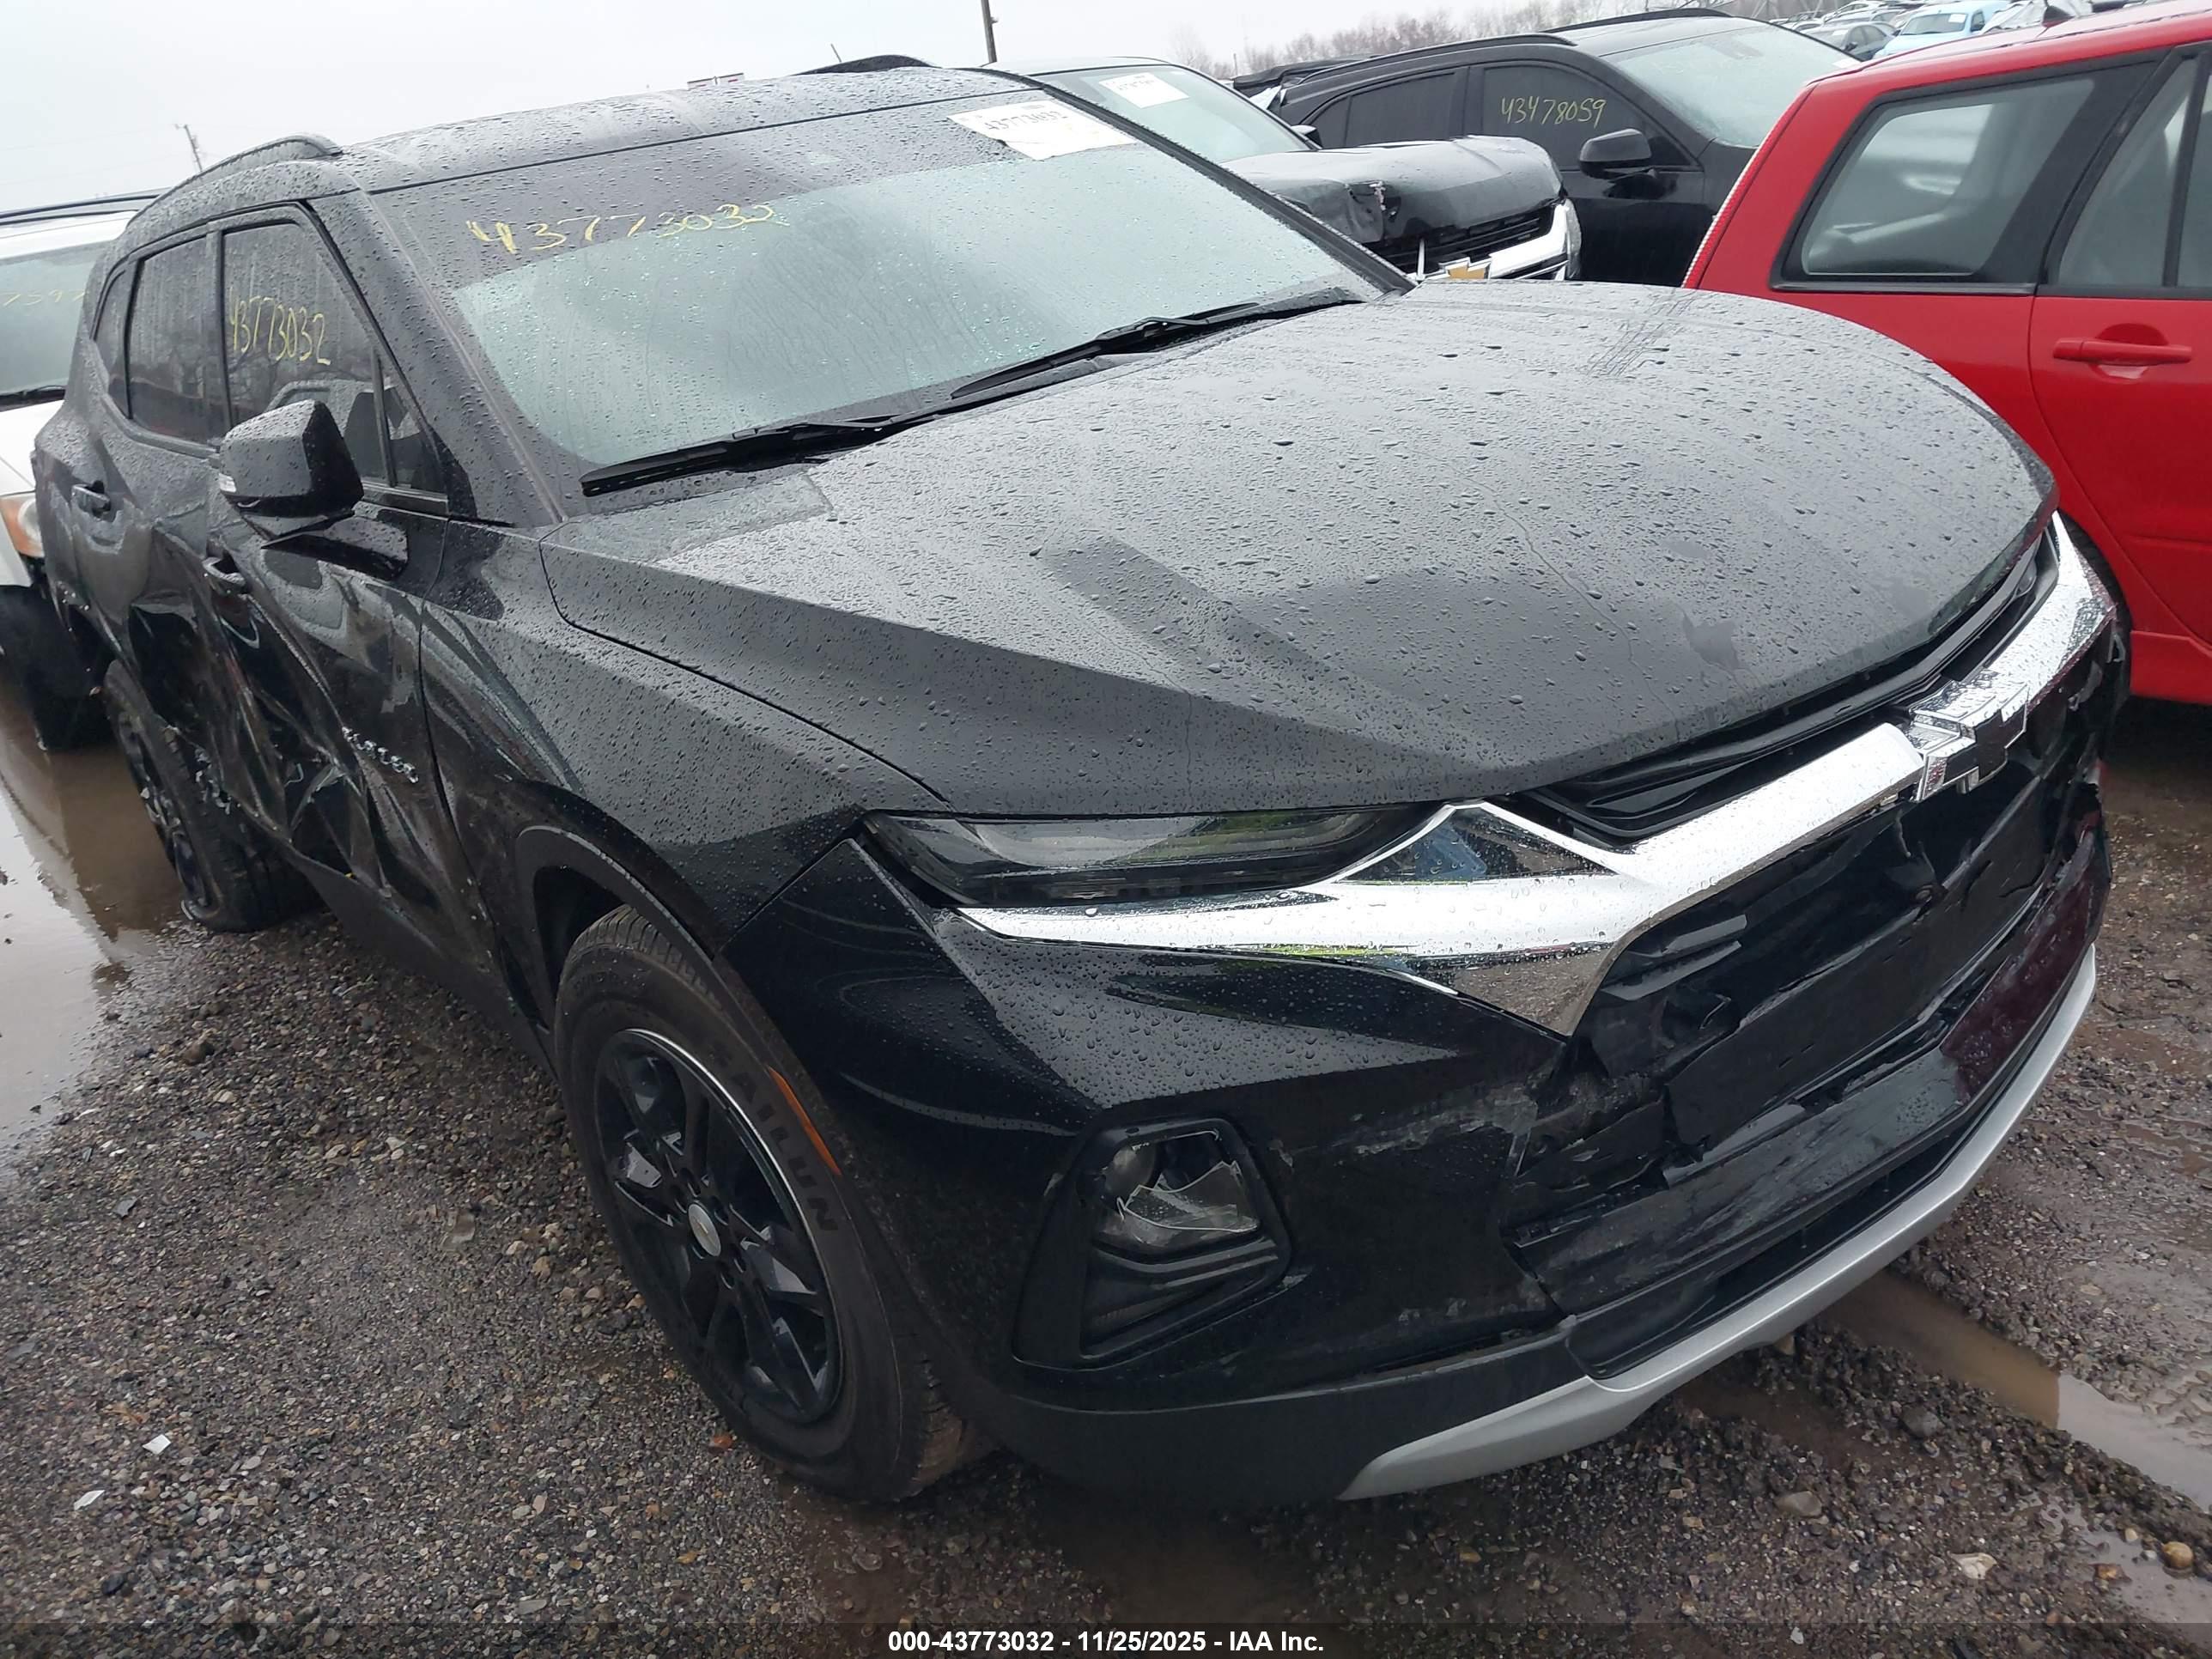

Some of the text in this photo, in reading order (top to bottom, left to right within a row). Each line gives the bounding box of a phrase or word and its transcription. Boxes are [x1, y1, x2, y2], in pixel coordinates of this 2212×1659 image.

[1501, 95, 1607, 129] 43478059
[465, 204, 790, 255] 43773032
[229, 286, 331, 366] 43773032
